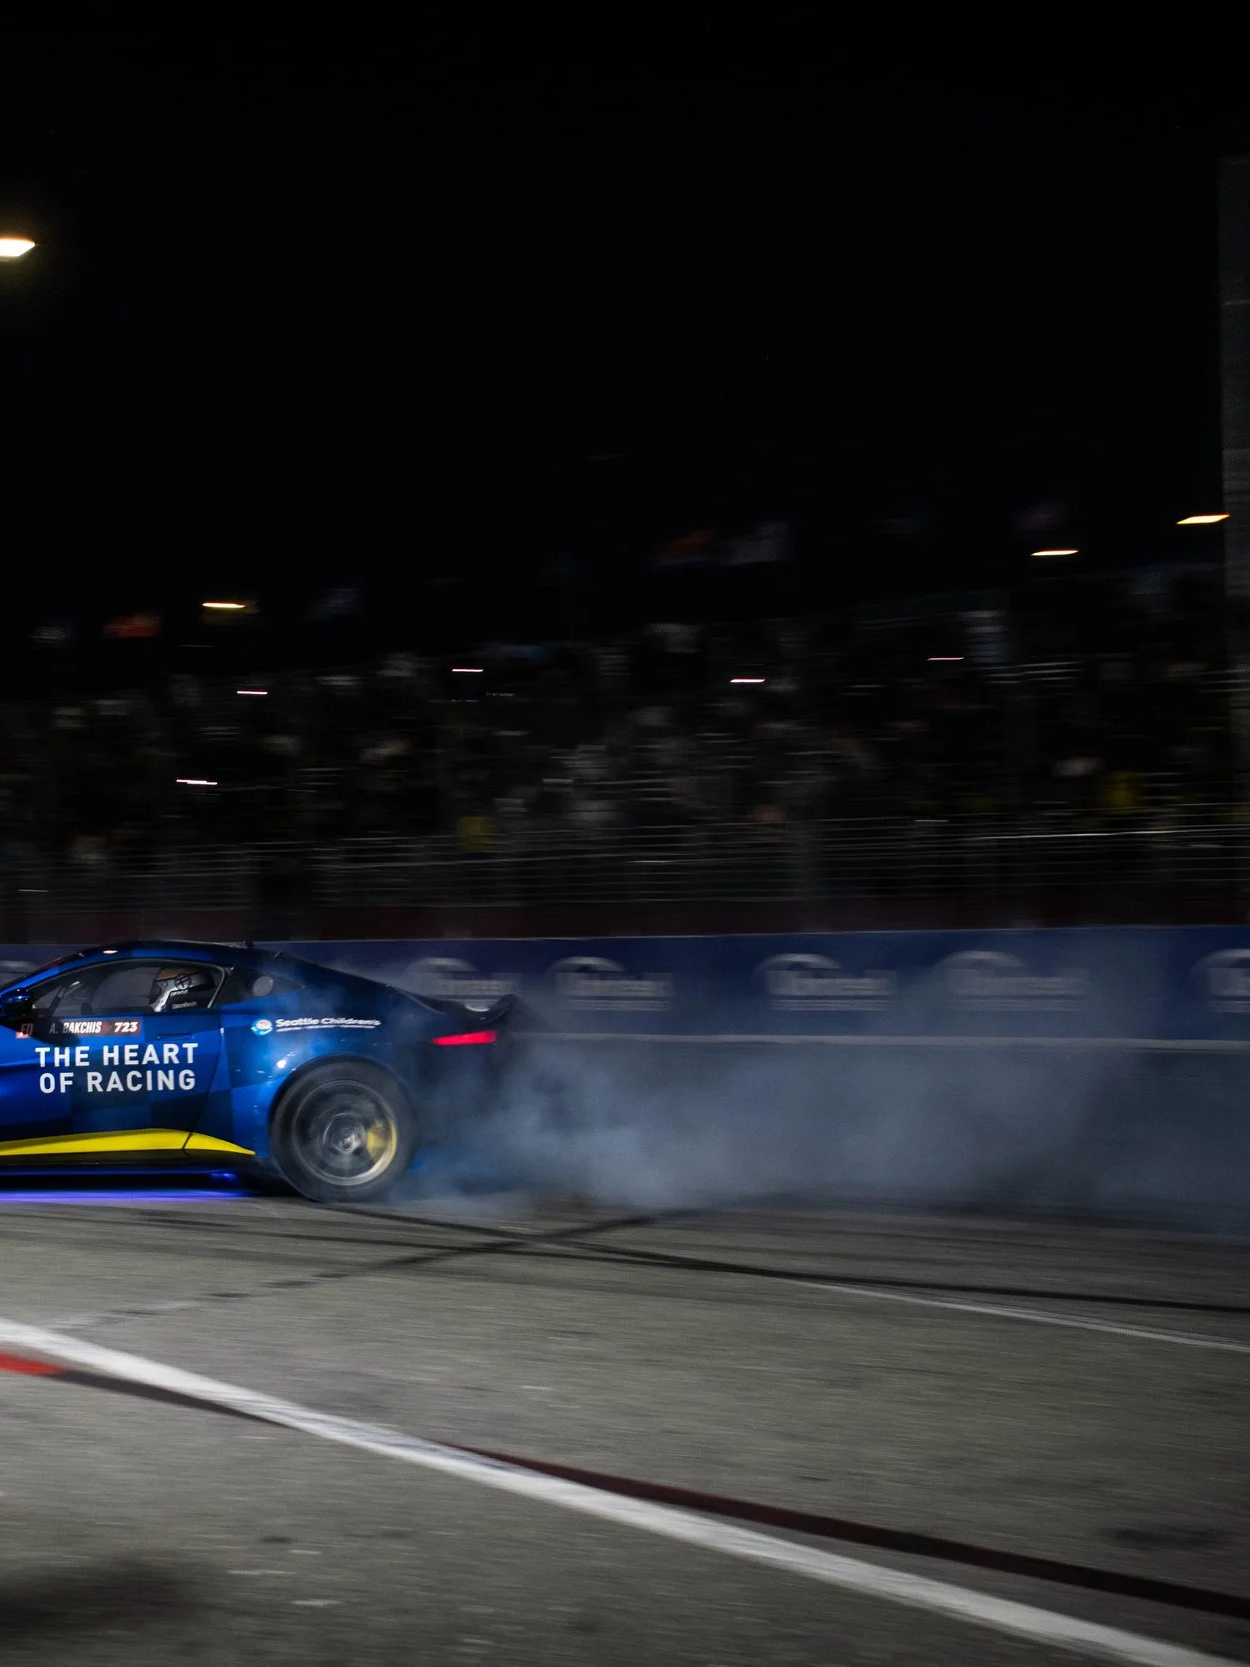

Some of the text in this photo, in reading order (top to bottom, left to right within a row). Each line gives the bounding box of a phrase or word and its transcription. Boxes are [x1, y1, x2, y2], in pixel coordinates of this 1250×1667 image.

[114, 1021, 138, 1033] 723
[275, 1018, 319, 1028] Seattle
[35, 1042, 199, 1068] THE HEART
[39, 1069, 196, 1094] OF RACING
